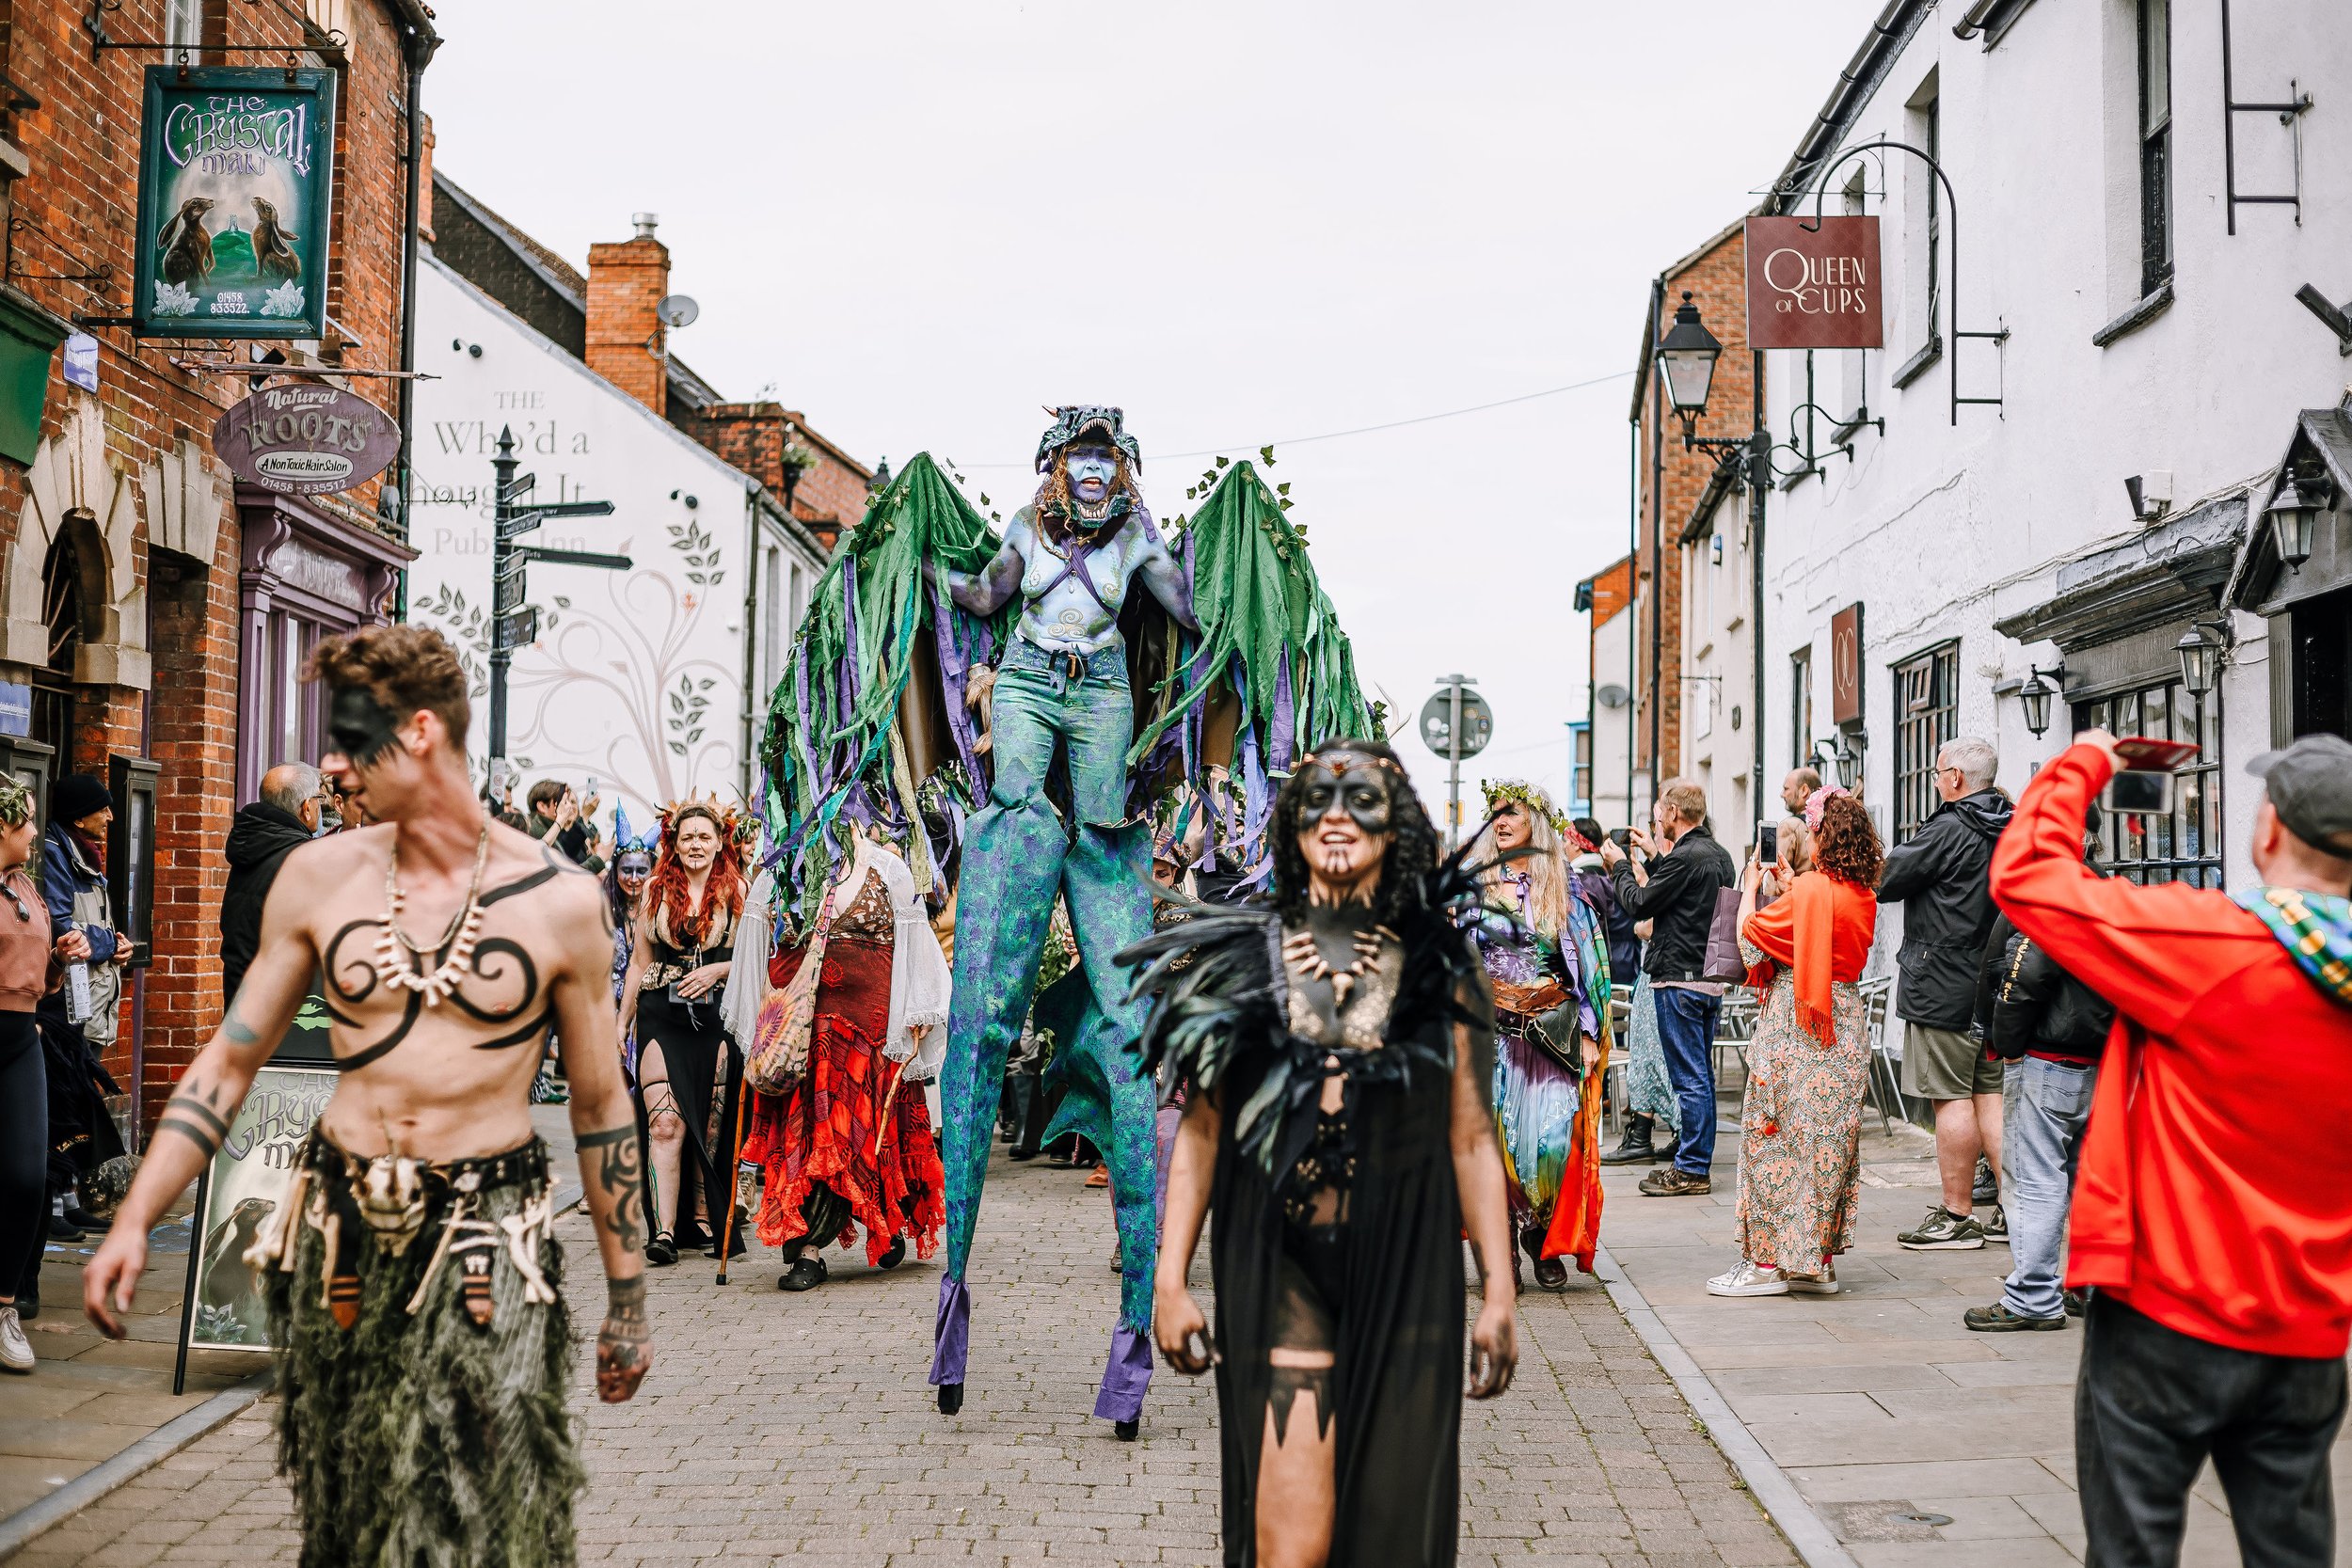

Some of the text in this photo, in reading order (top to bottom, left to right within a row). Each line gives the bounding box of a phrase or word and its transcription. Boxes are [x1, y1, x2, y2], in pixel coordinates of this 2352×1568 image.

[1763, 247, 1867, 301] QUEEN
[216, 293, 244, 303] 01458
[1797, 288, 1867, 314] CUPS
[265, 388, 340, 411] Natural
[494, 391, 544, 409] THE
[240, 412, 372, 453] ROOTS
[572, 431, 590, 454] a
[262, 457, 348, 471] A Non Toxic Hair Salon
[261, 477, 294, 492] 01458
[434, 527, 490, 556] Pub
